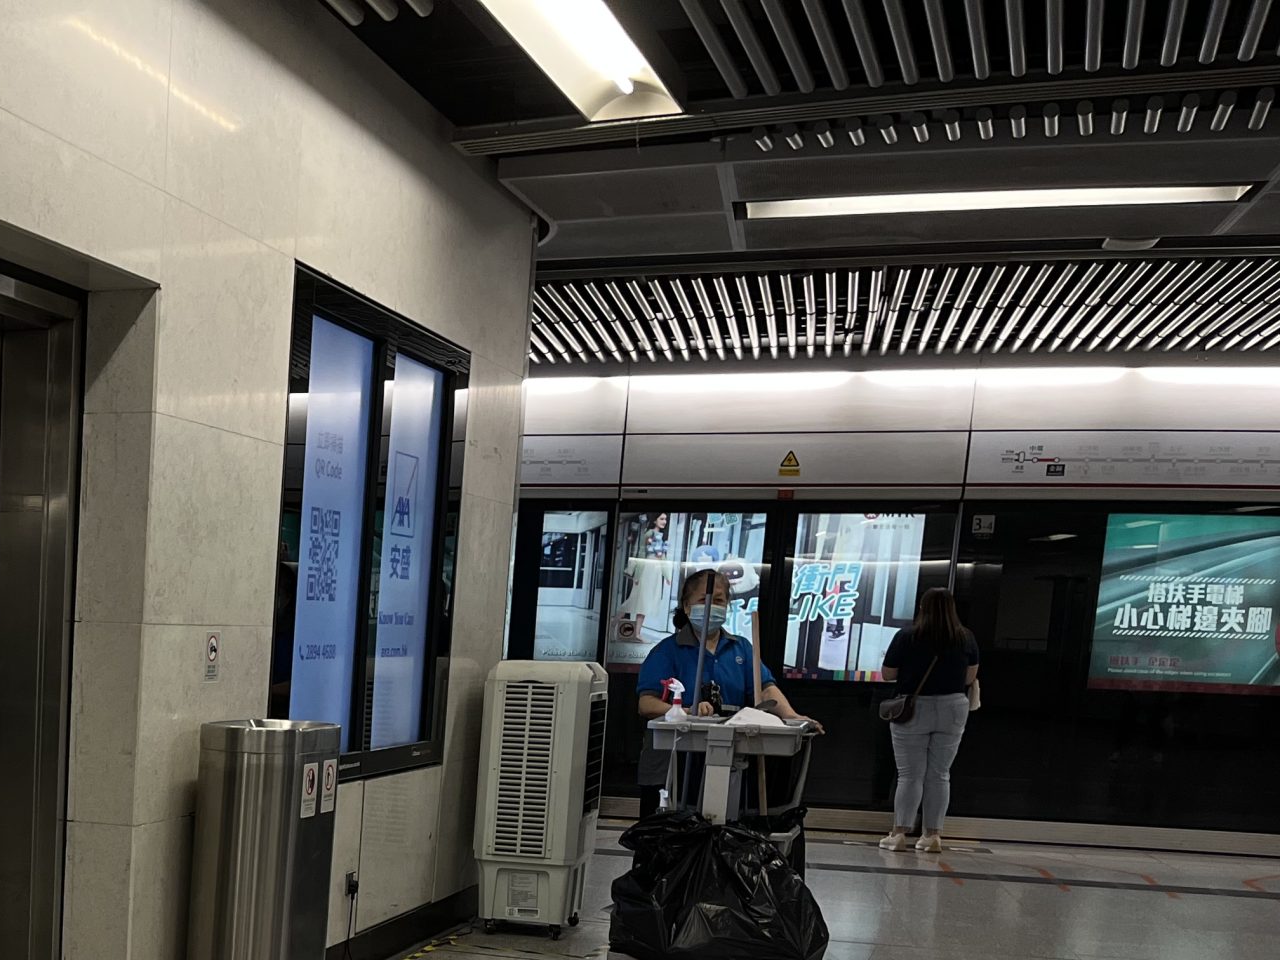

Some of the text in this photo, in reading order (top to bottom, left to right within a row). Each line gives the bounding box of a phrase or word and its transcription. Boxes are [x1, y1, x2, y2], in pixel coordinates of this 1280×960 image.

[391, 496, 410, 528] AXA
[389, 544, 412, 580] 安盛
[1148, 582, 1245, 605] 搭扶手電梯
[1113, 603, 1273, 634] 小心梯邊夾腳
